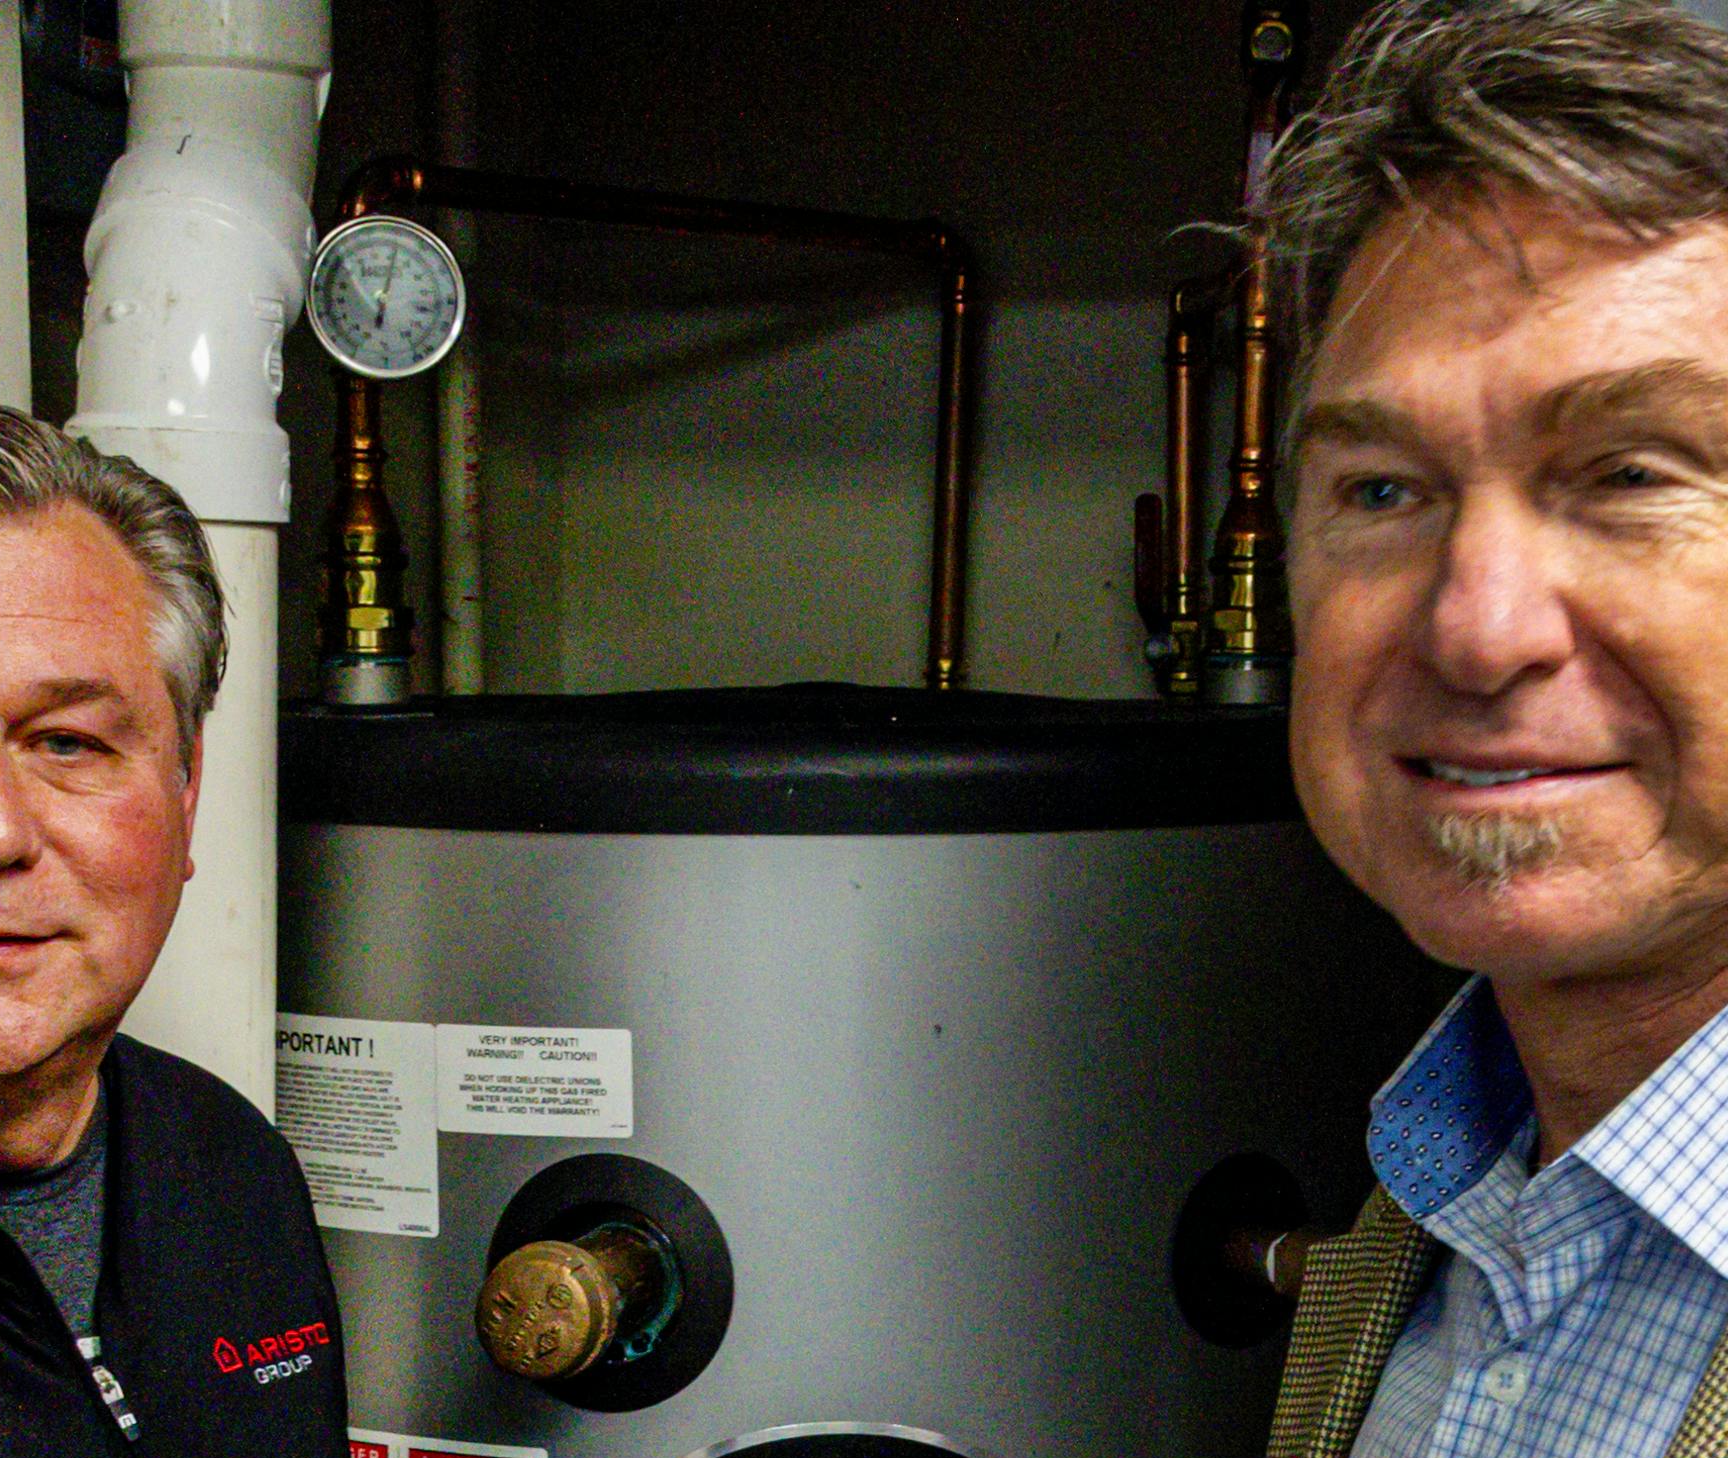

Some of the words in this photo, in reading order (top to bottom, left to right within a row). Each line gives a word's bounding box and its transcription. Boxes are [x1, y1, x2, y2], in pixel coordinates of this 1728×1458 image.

[479, 1035, 506, 1046] VERY
[510, 1036, 579, 1047] IMPORTANT!
[478, 1074, 494, 1083] NOT
[529, 1106, 545, 1115] THE
[254, 1354, 313, 1384] GROUP
